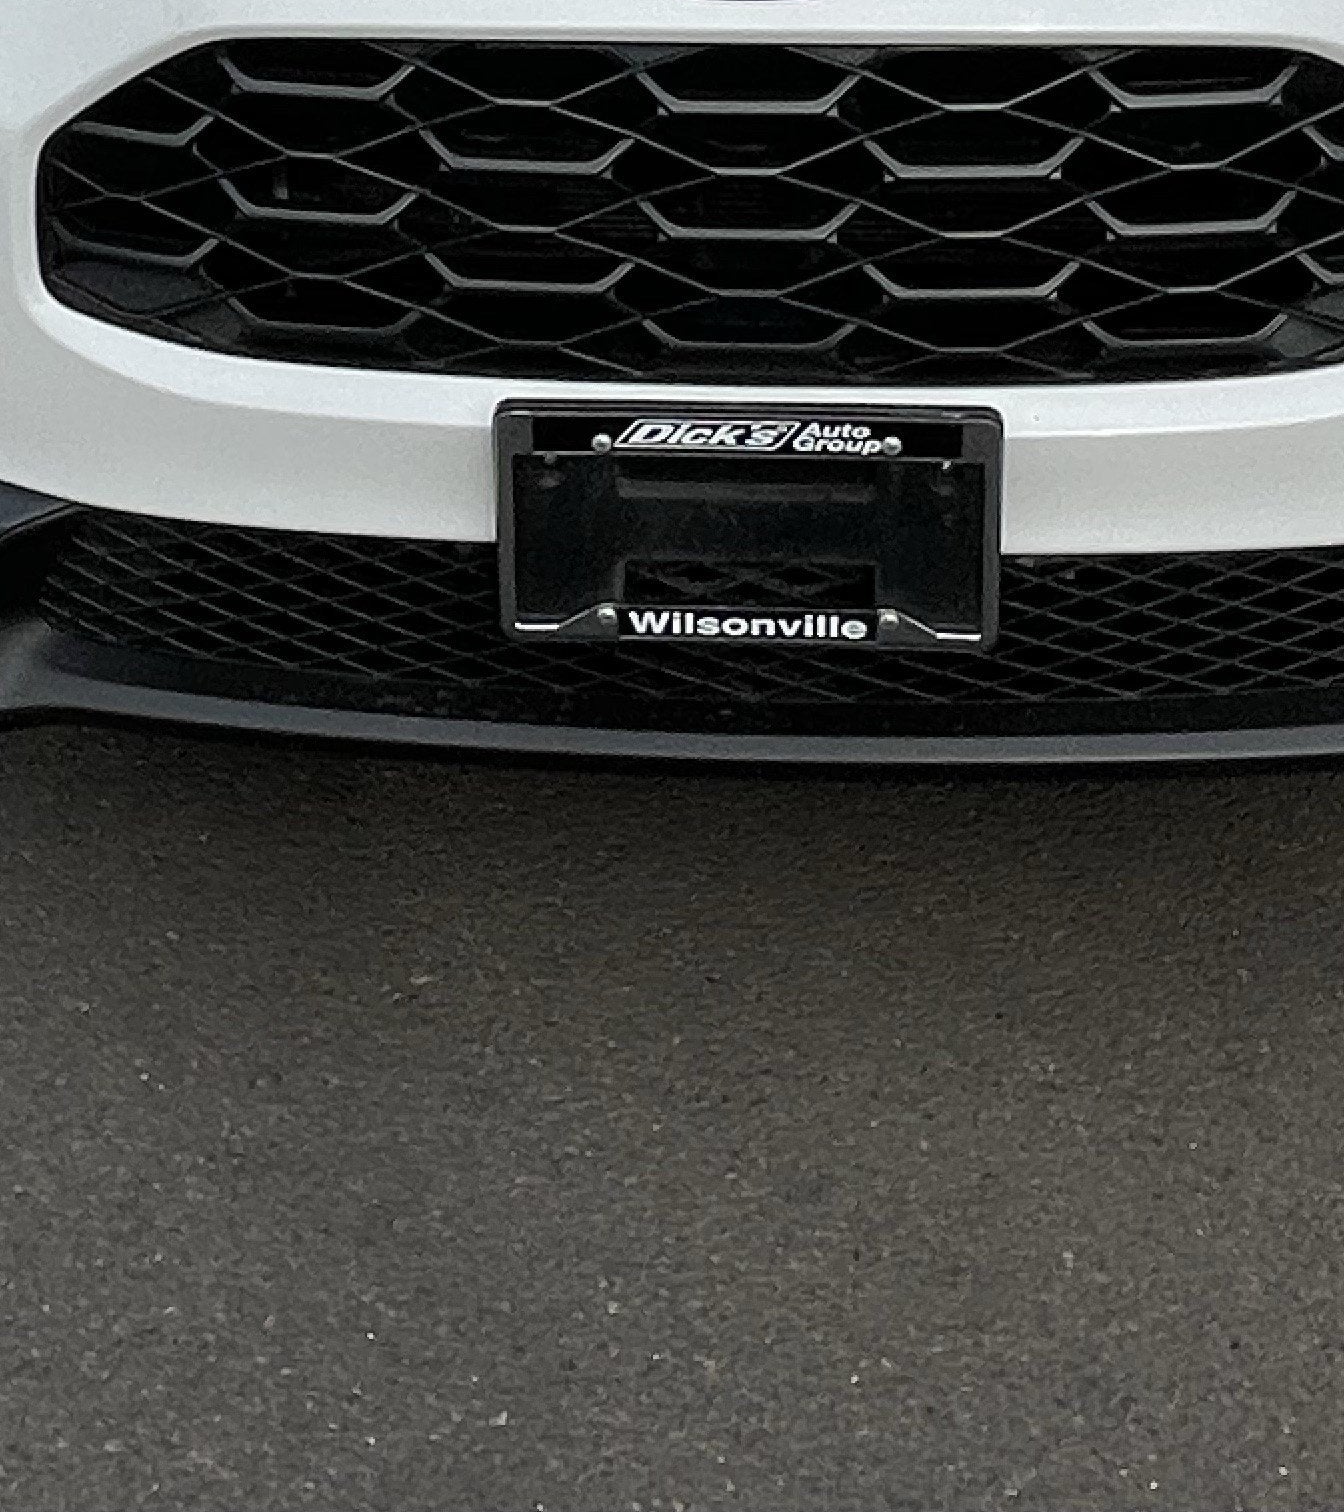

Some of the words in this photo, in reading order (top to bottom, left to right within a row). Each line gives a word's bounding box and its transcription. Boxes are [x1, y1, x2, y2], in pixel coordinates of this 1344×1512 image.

[799, 422, 872, 439] Auto
[793, 437, 883, 456] Group
[628, 610, 868, 639] Wilsonville
